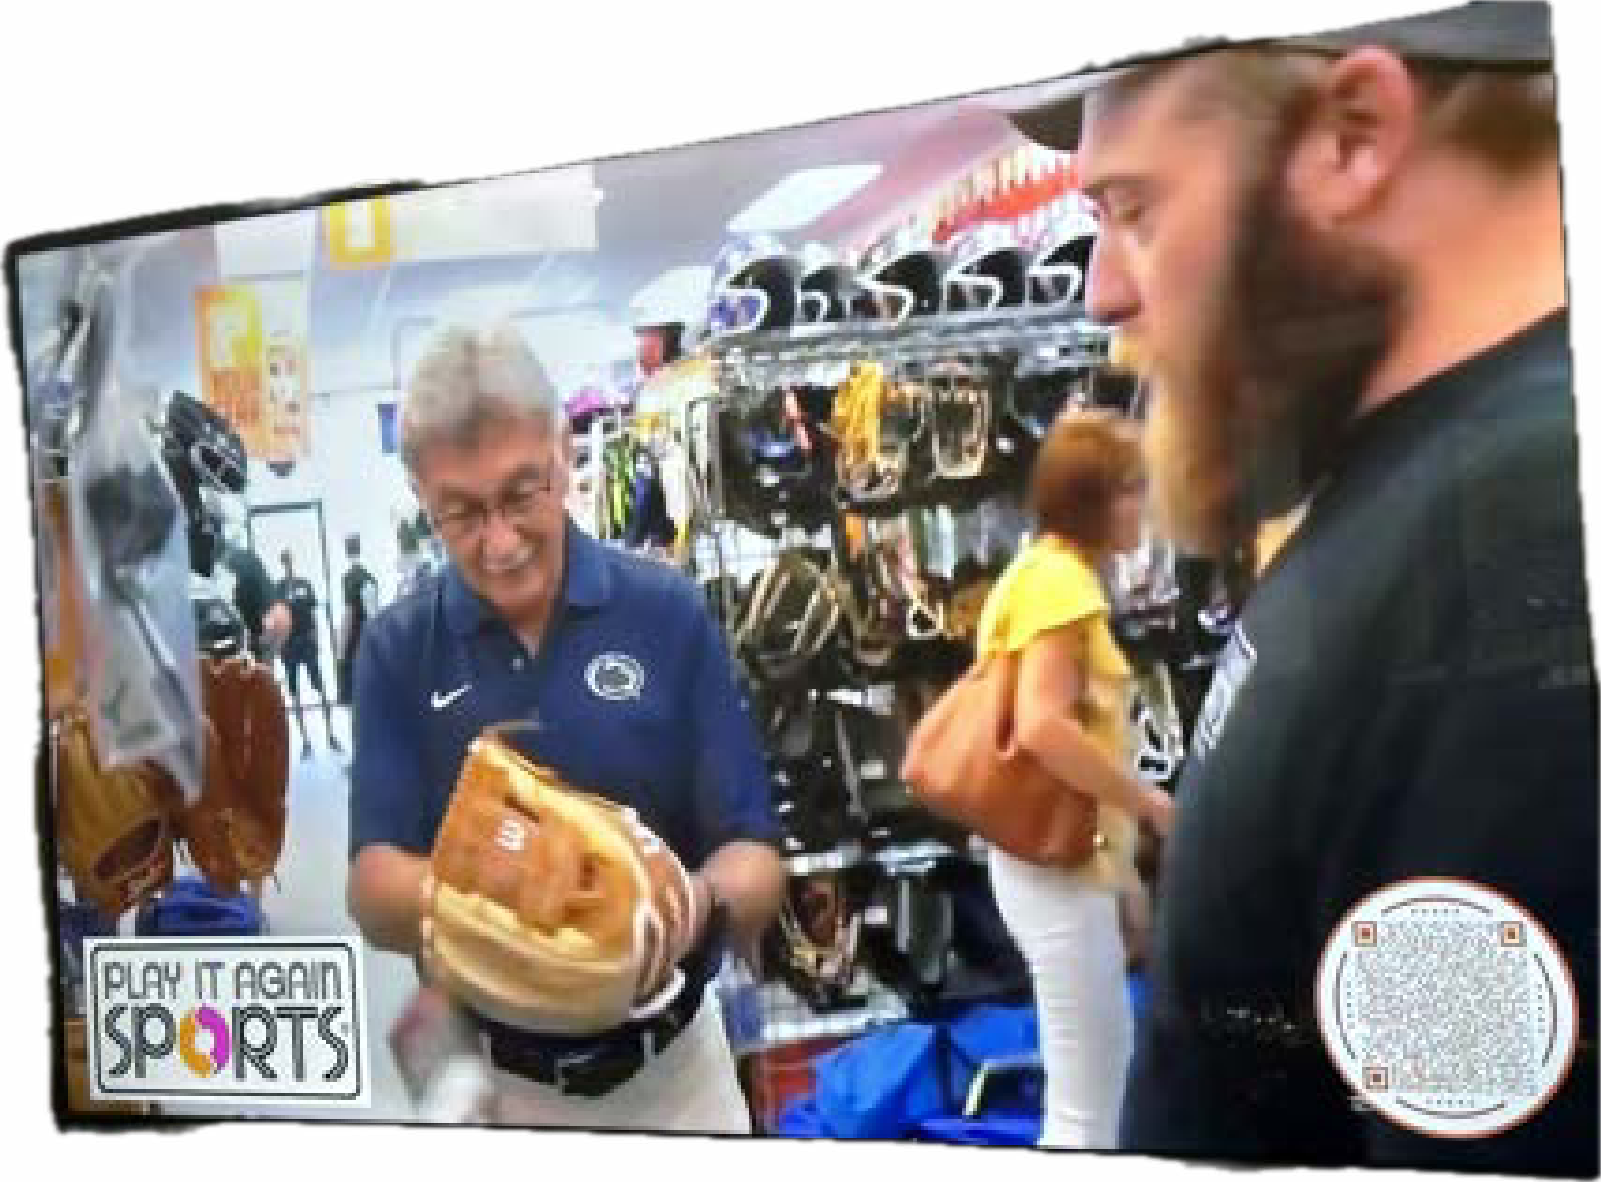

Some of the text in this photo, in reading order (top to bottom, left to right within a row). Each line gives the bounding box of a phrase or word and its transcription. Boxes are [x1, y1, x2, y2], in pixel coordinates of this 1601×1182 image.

[104, 961, 342, 1000] PLAY IT AGAIN
[104, 1003, 350, 1082] SPORTS
